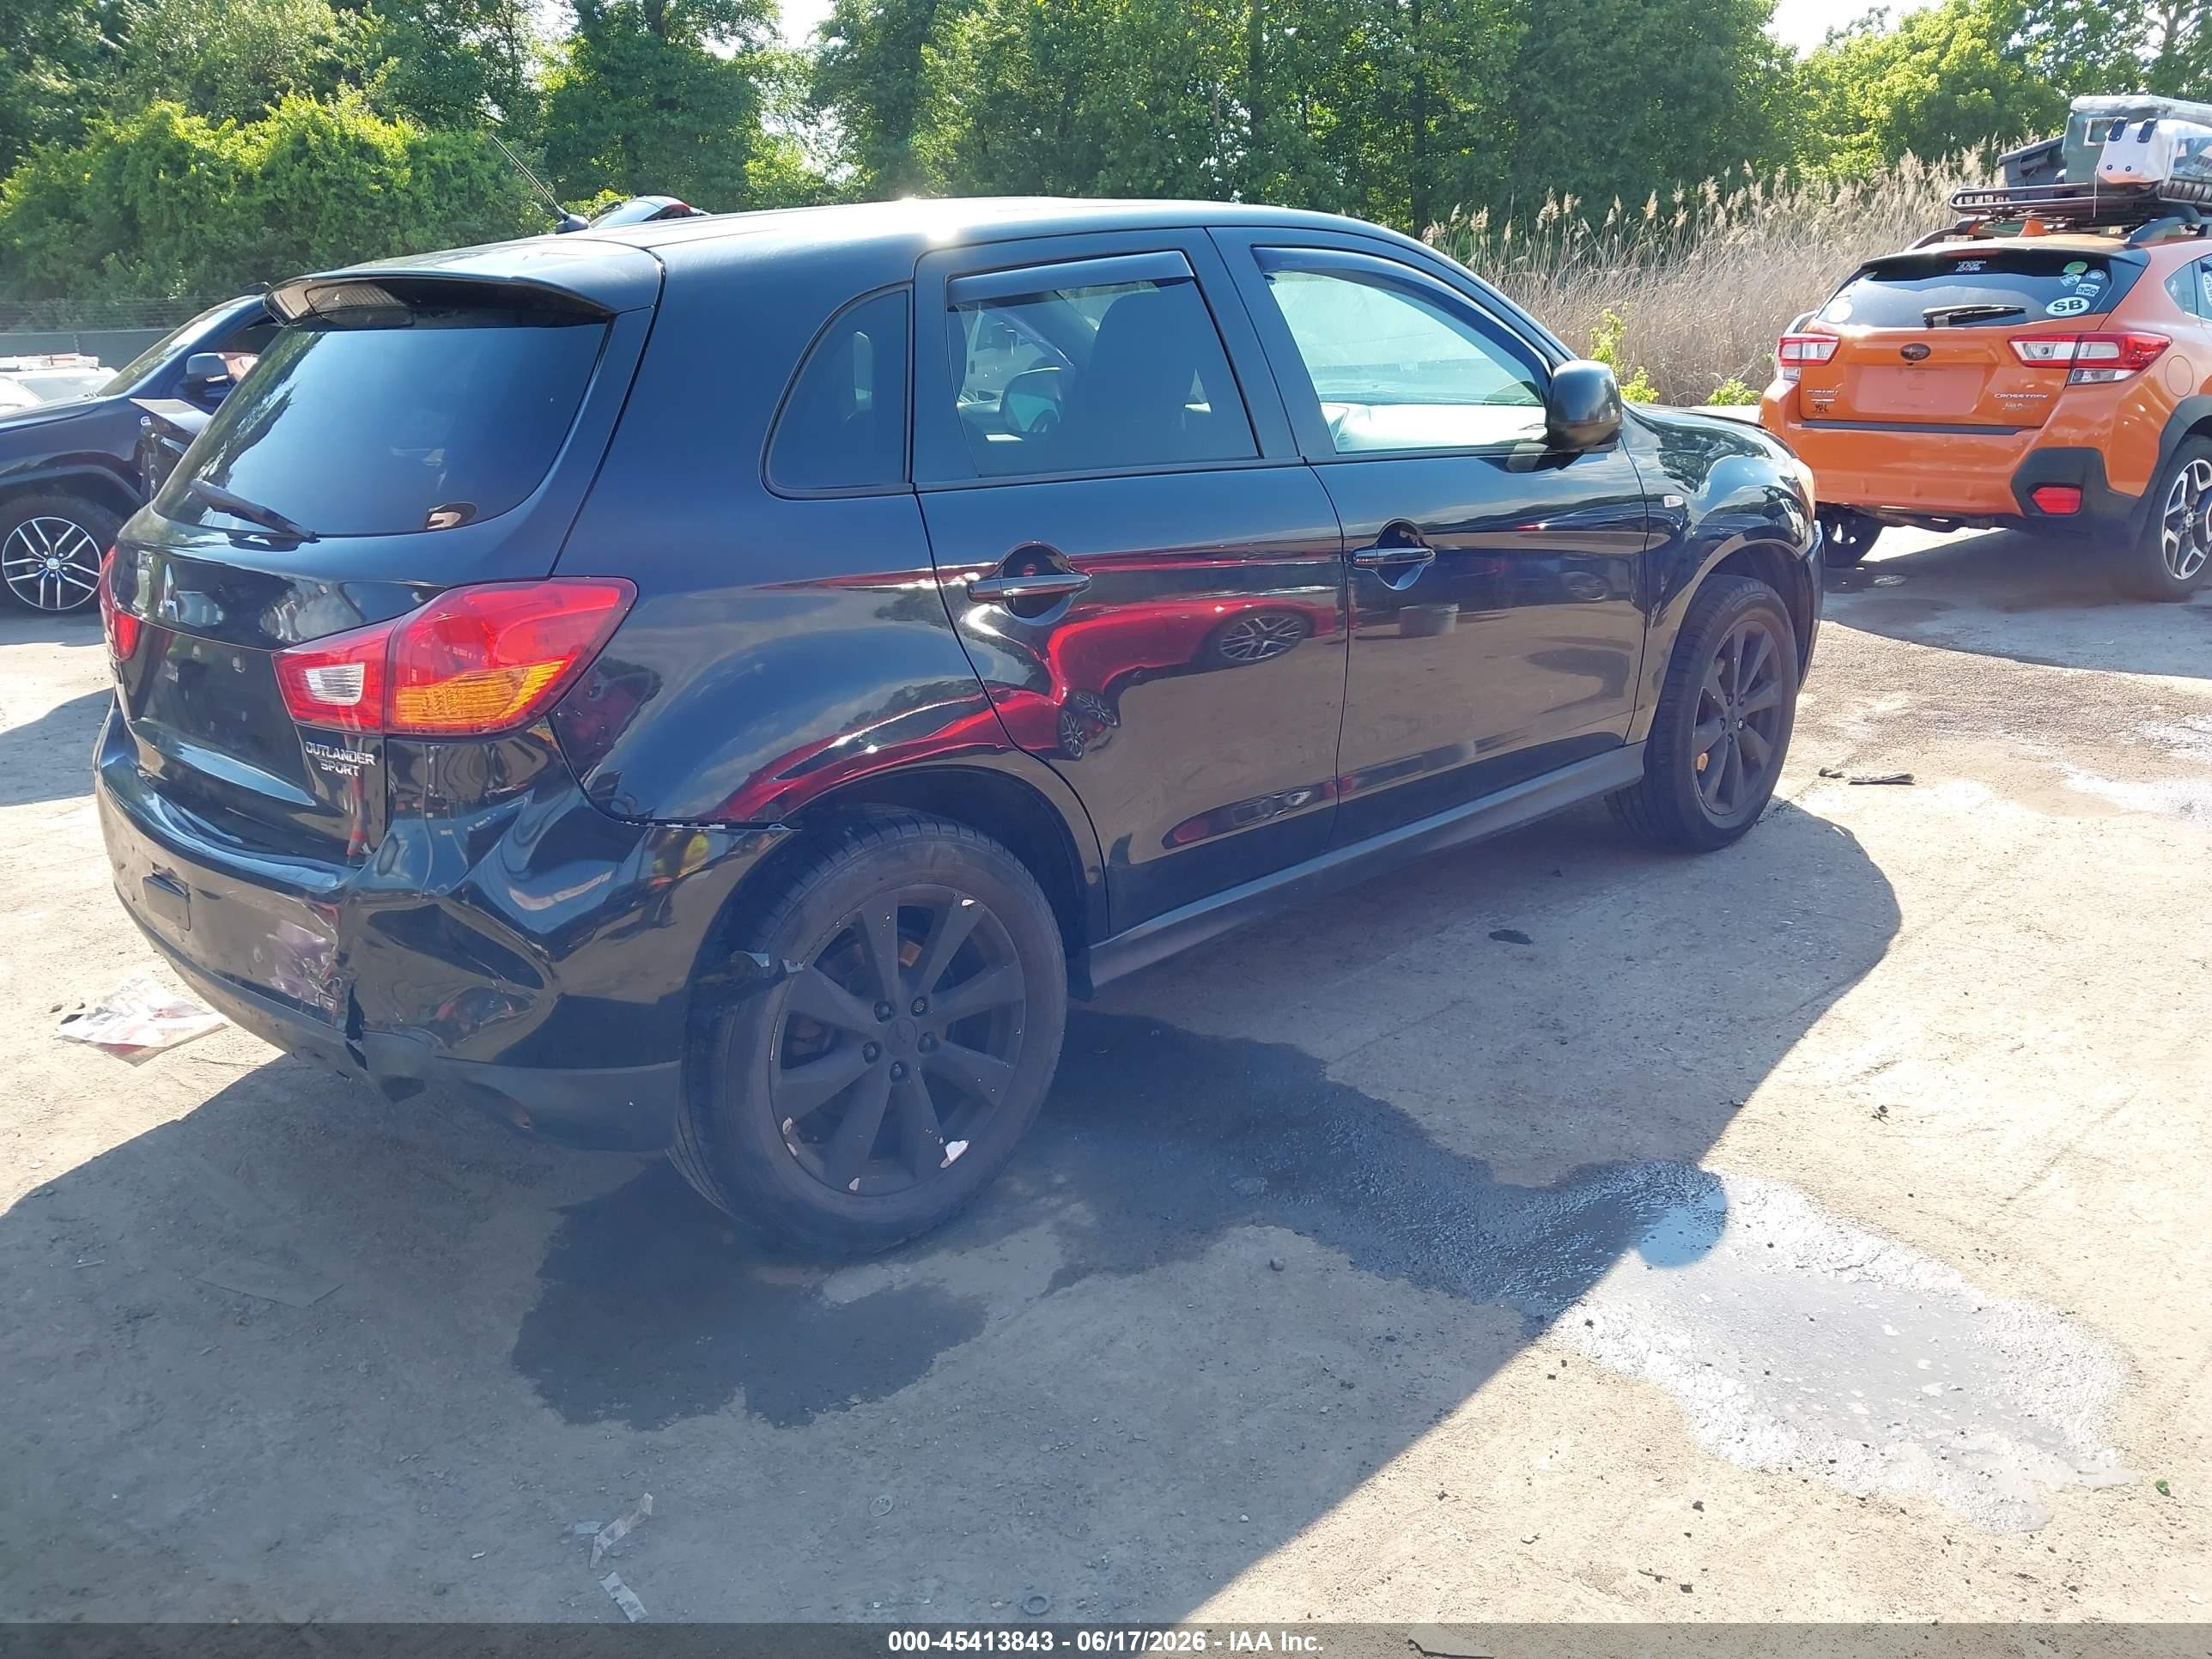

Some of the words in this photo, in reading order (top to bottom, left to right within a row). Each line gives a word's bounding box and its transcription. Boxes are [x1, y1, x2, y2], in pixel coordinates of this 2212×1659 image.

[2052, 299, 2083, 313] SB
[305, 741, 377, 766] OUTLANDER
[320, 760, 361, 777] SPORT
